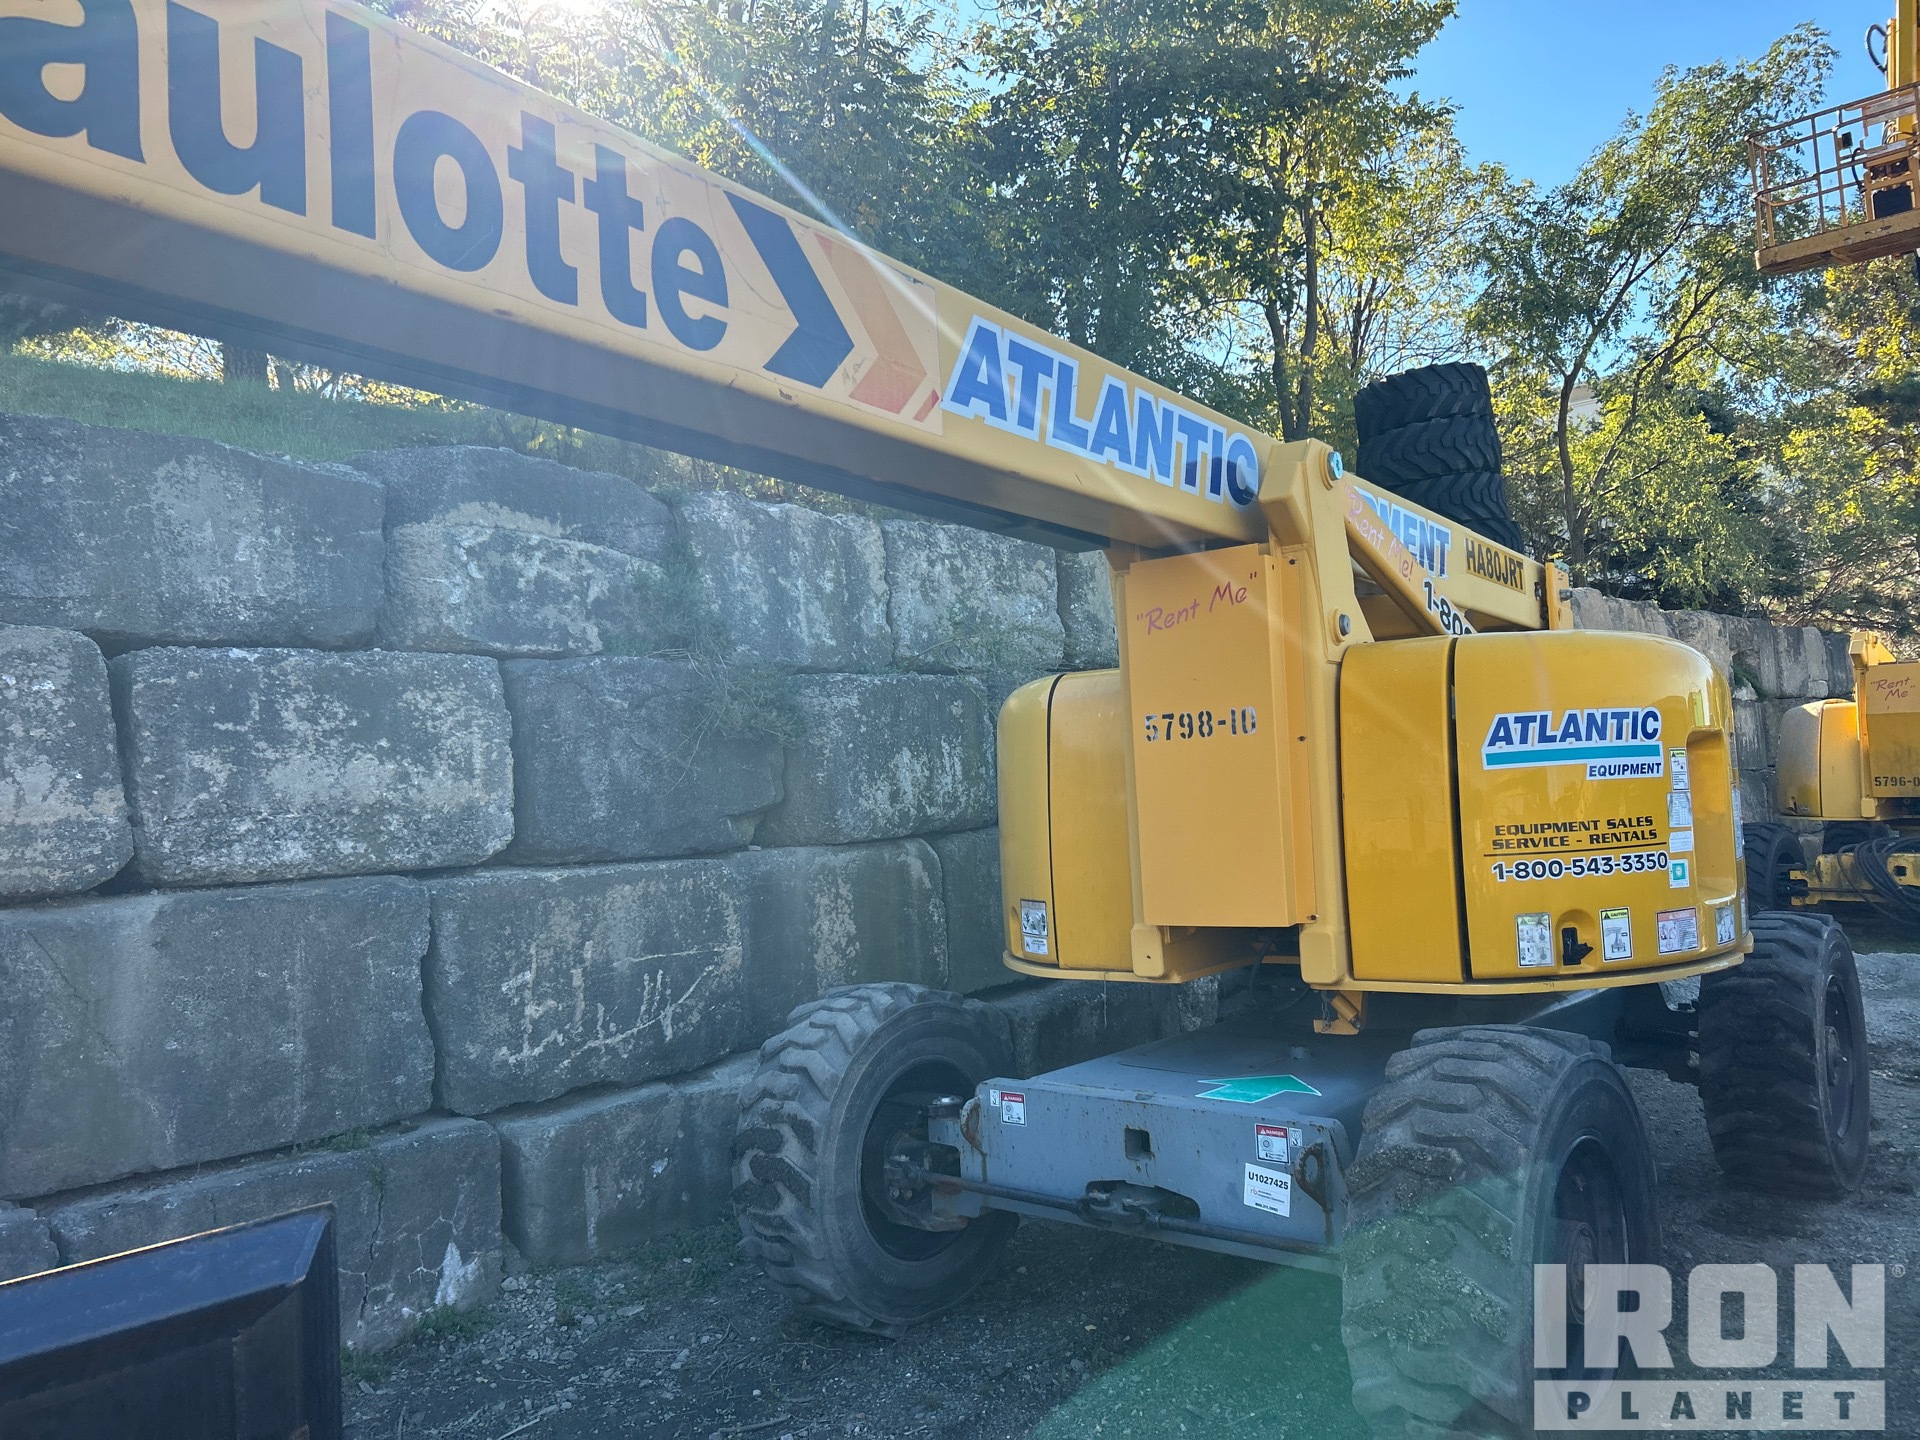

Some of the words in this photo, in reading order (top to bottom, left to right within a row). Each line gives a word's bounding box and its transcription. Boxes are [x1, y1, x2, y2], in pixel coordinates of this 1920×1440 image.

[0, 0, 729, 351] aulotte
[941, 315, 1259, 512] ATLANTIC
[1465, 537, 1524, 590] HA80JRT
[1423, 579, 1474, 635] 1-80
[1144, 706, 1257, 742] 5798-10
[1486, 709, 1660, 747] ATLANTIC
[1588, 762, 1662, 777] EQUIPMENT
[1492, 835, 1570, 850] SERVICE
[1589, 828, 1658, 845] RENTALS
[1494, 819, 1601, 837] EQUIPMENT
[1606, 815, 1654, 830] SALES
[1491, 851, 1669, 881] 1-800-543-3350
[1265, 1129, 1285, 1137] DANGER
[1248, 1171, 1289, 1190] U1027425
